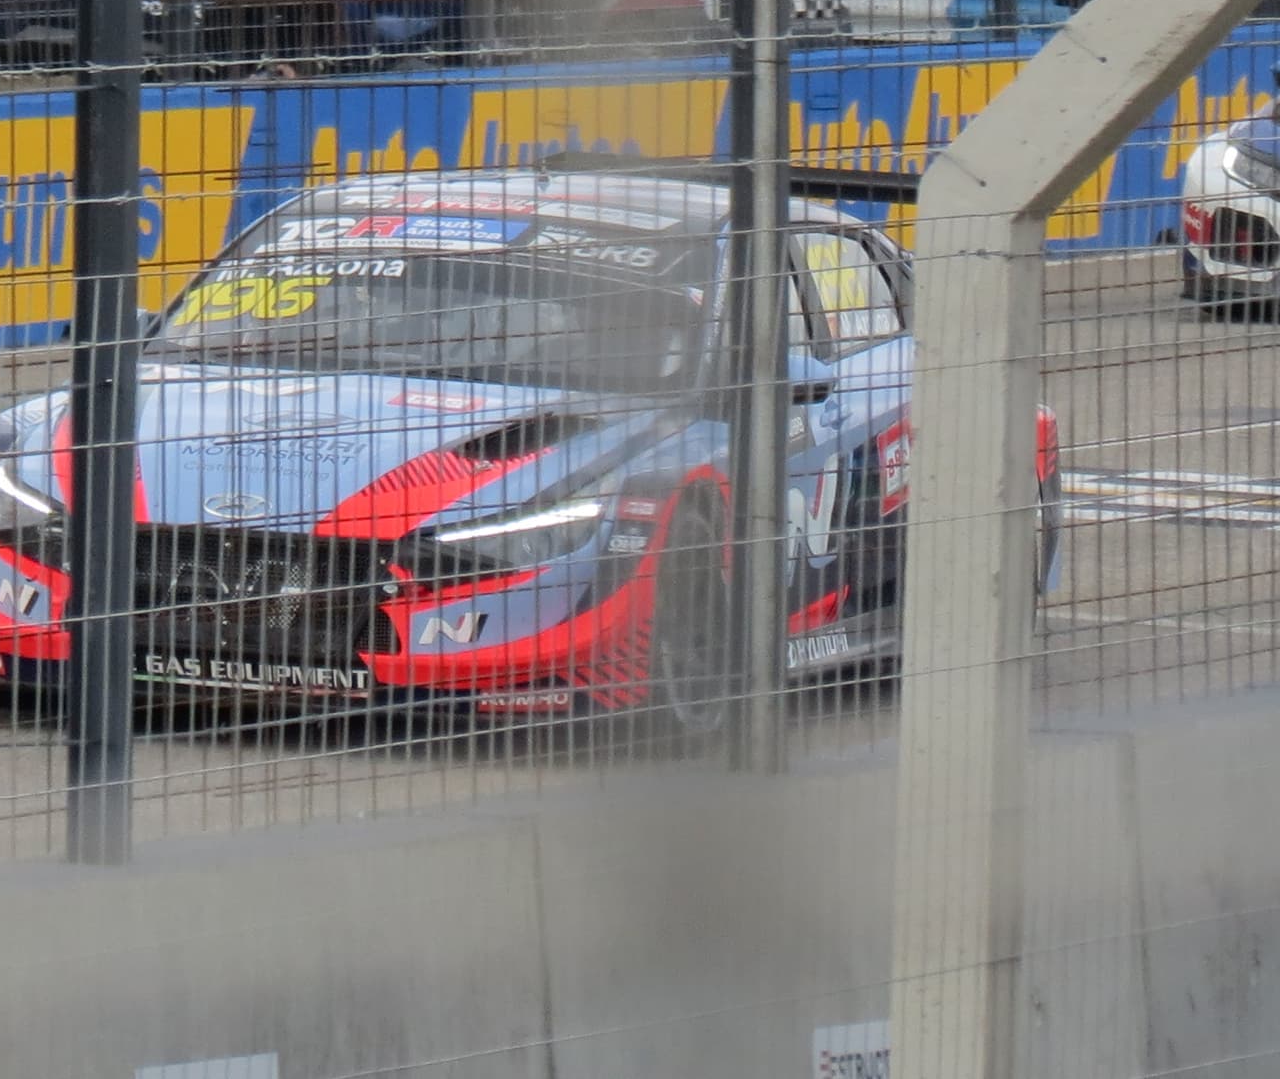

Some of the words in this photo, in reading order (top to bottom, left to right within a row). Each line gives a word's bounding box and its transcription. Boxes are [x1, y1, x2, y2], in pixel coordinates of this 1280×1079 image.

[276, 216, 408, 242] TCR
[176, 277, 333, 325] 196
[146, 653, 201, 678] GAS
[210, 659, 370, 689] EQUIPMENT
